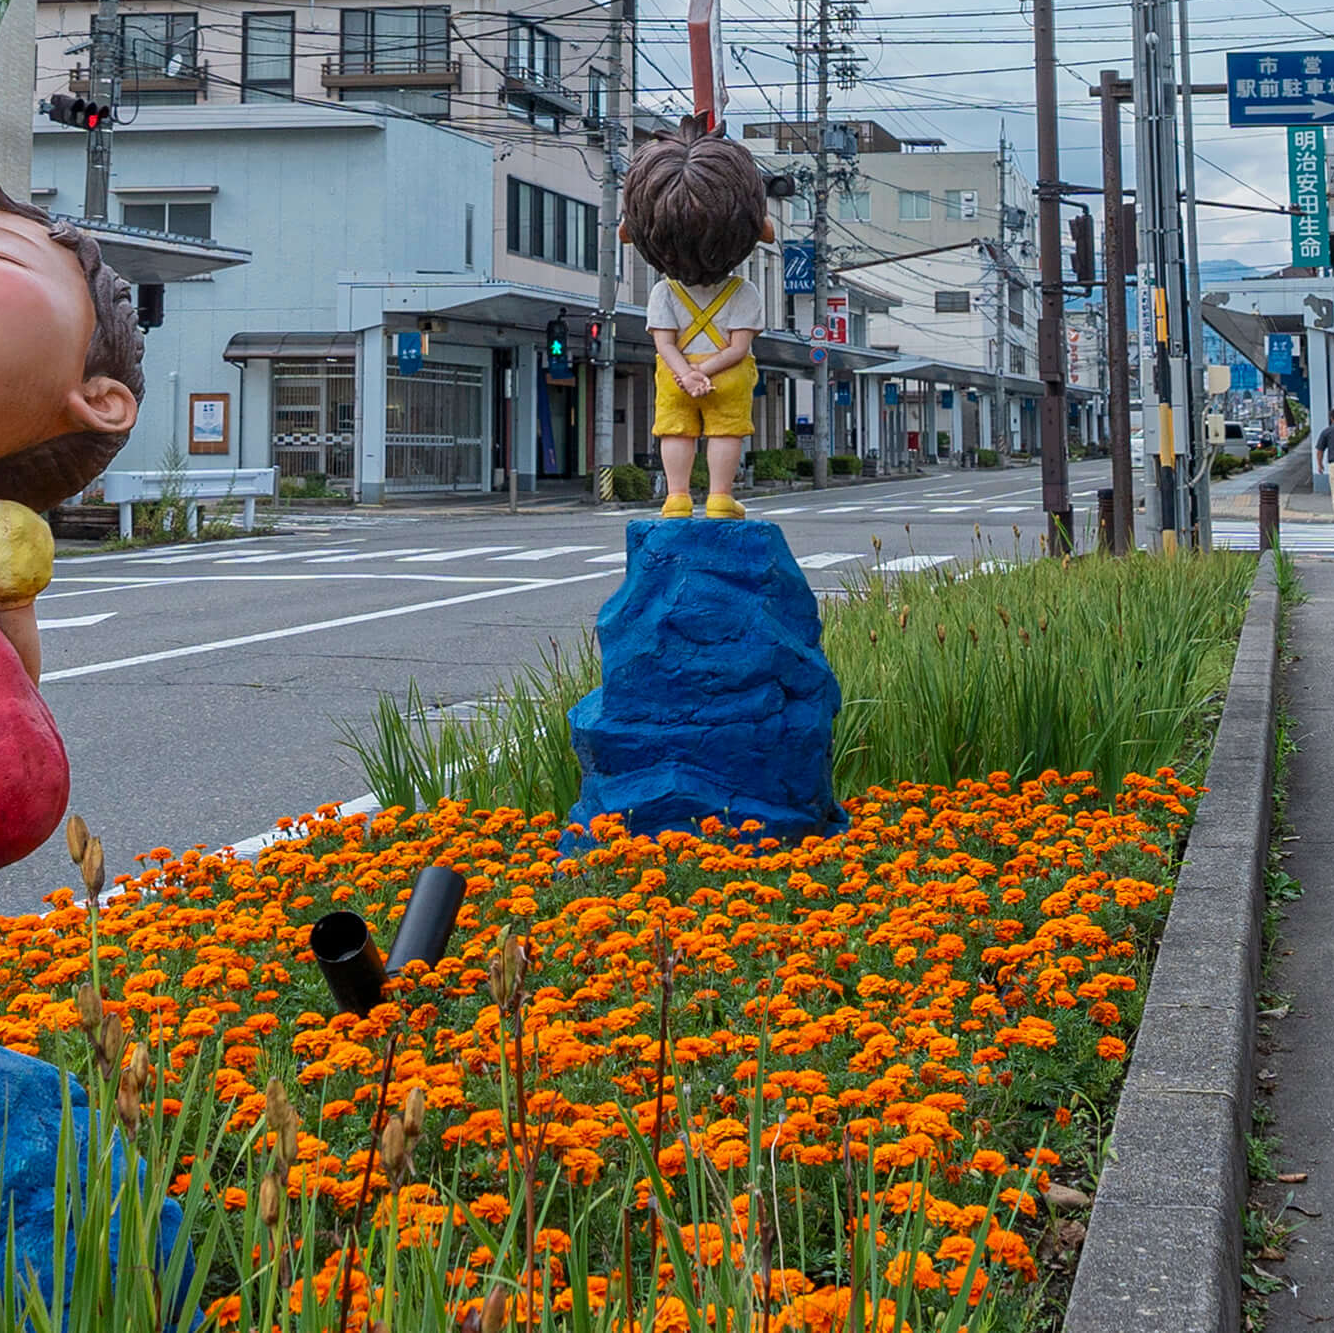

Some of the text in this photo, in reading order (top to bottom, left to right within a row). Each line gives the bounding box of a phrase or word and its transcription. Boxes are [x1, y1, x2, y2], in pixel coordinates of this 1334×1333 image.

[1295, 131, 1321, 258] 明治安田生命
